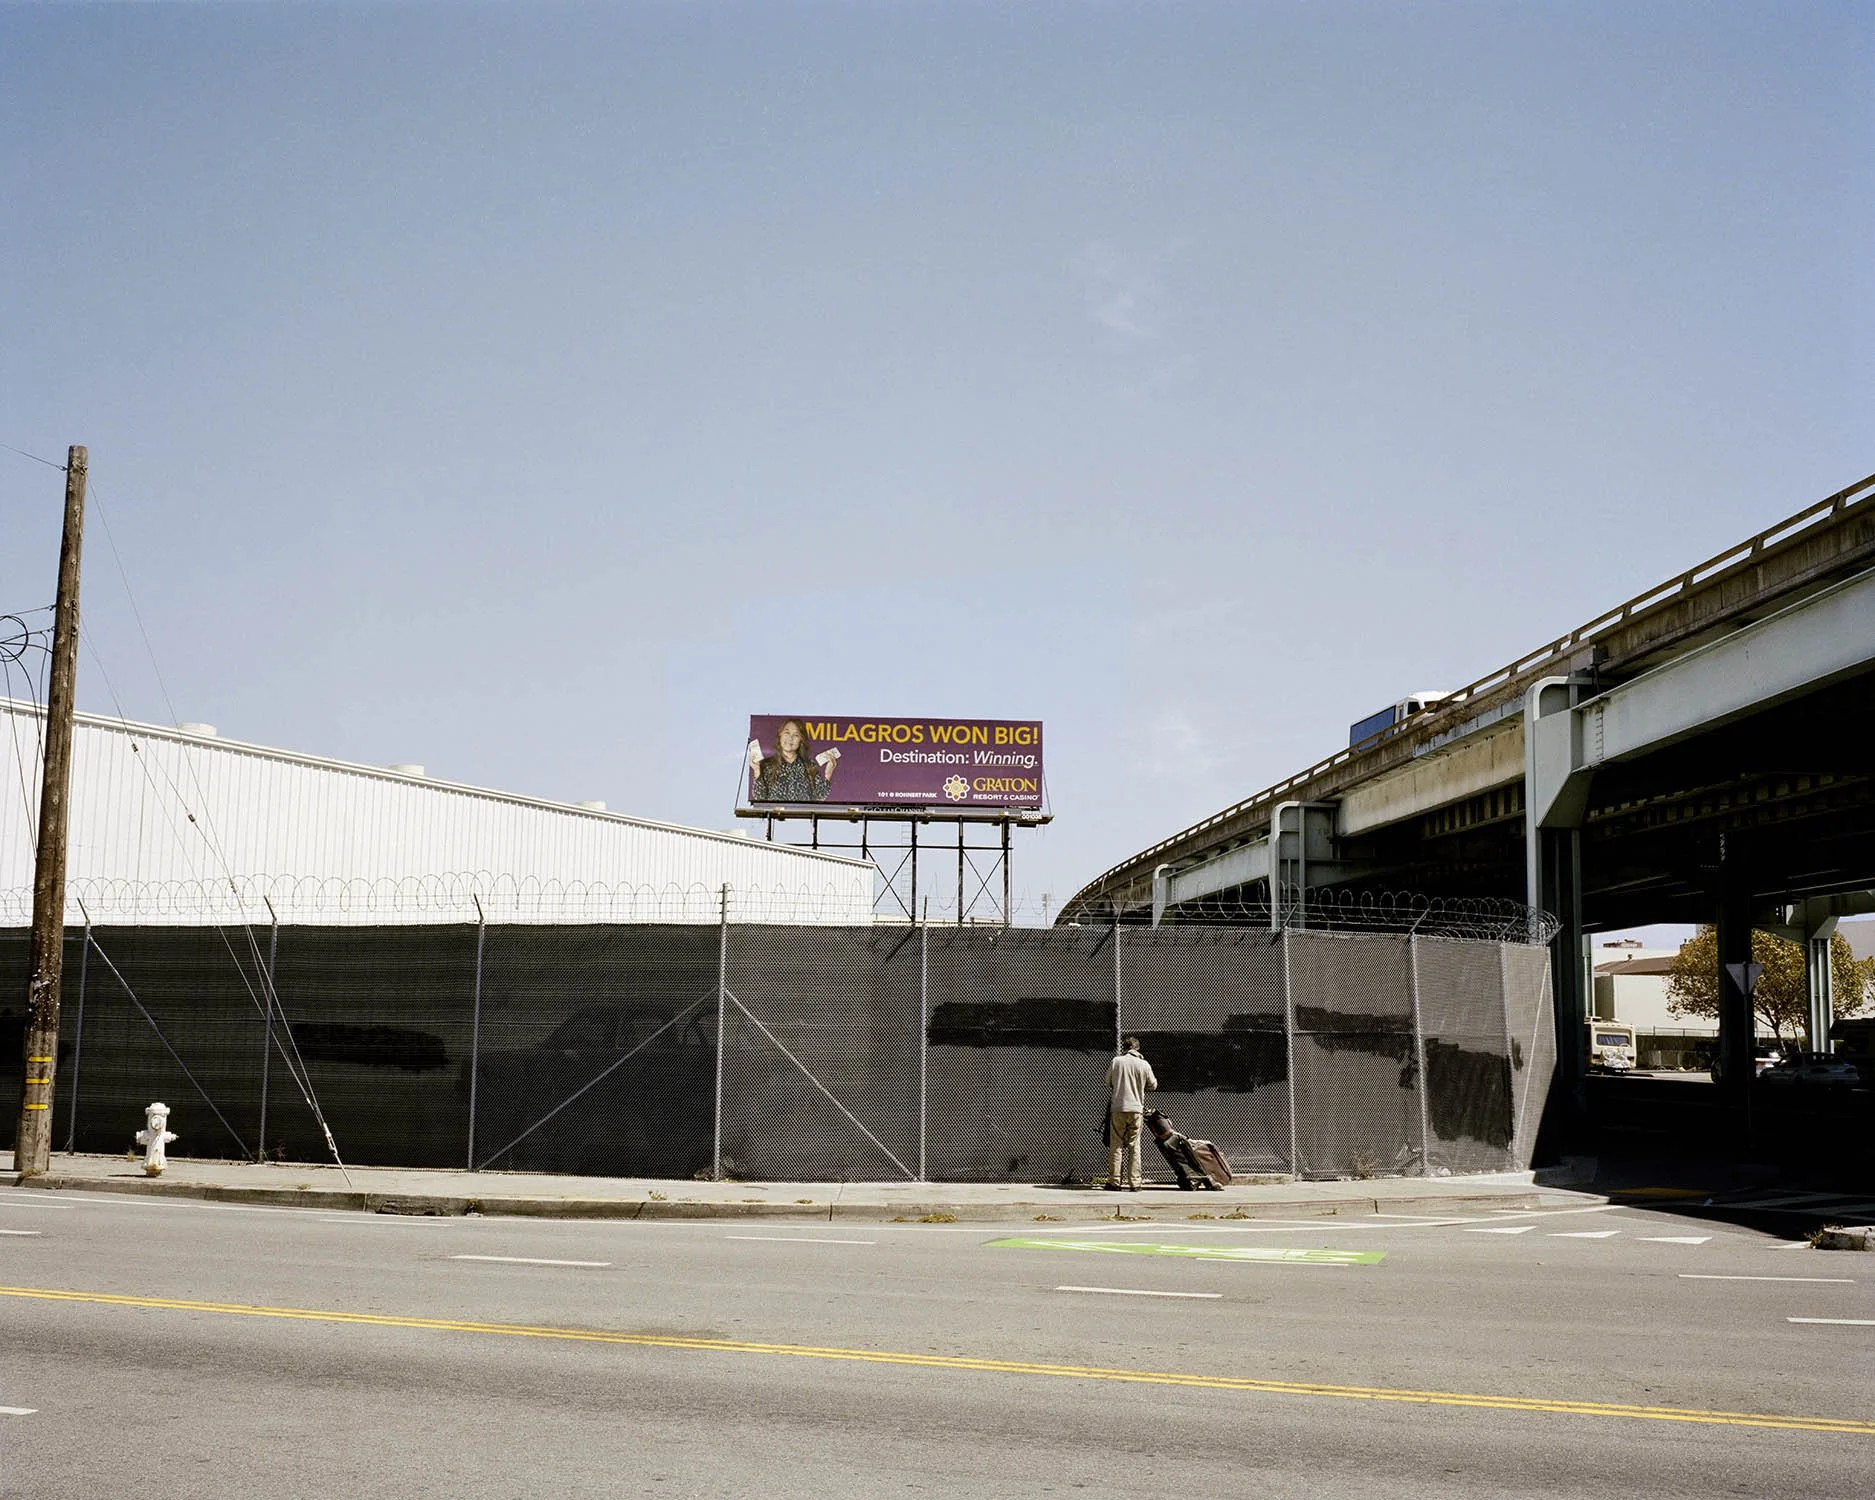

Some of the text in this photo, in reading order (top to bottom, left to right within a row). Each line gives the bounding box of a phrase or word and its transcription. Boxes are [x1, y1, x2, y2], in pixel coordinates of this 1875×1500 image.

[805, 722, 1038, 745] MILAGROS WON BIG!
[880, 748, 1038, 769] Destination: Winning.
[973, 777, 1038, 792] GRATON
